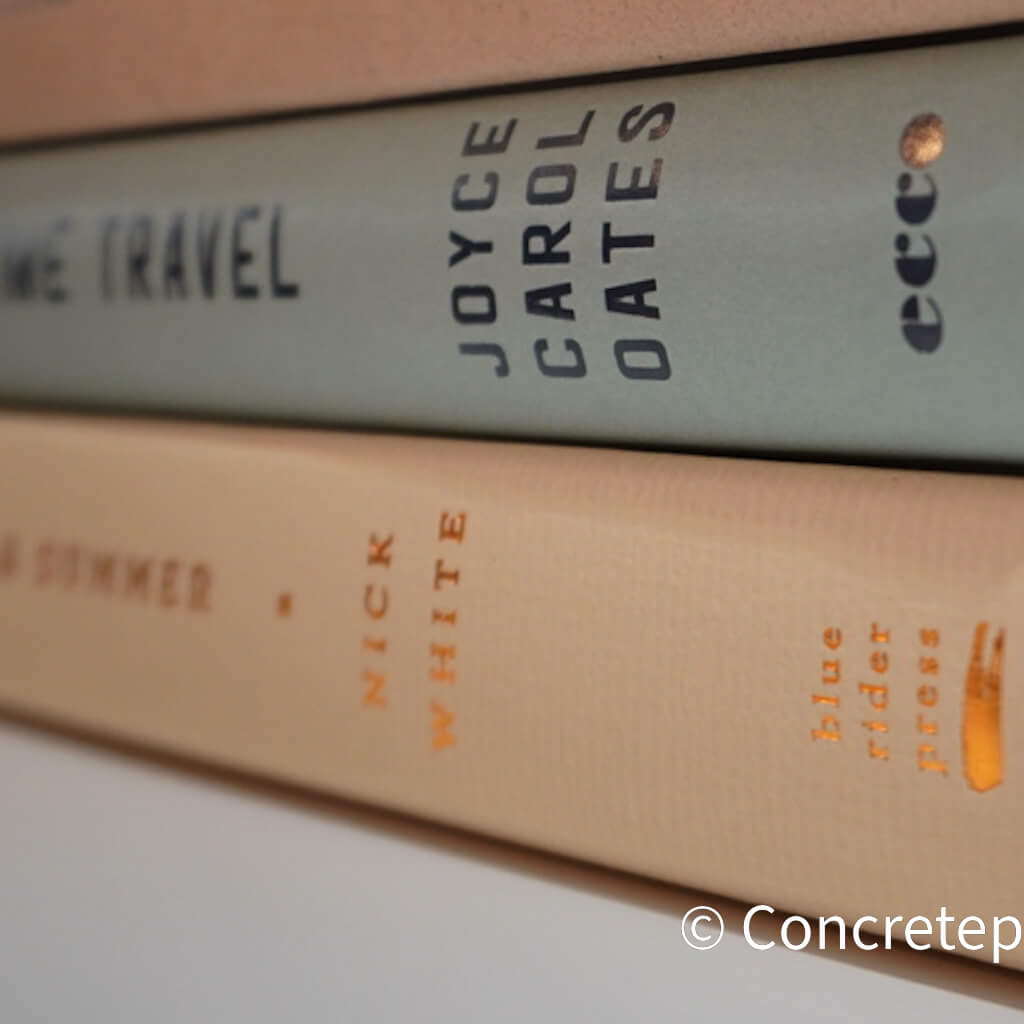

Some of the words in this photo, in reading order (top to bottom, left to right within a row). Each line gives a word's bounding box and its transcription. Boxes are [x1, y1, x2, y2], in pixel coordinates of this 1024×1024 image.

[99, 203, 299, 302] TRAVEL
[449, 117, 518, 378] JOYCE
[522, 109, 596, 378] CAROL
[602, 101, 676, 381] OATES
[361, 532, 395, 709] NICK
[429, 510, 467, 751] WHITE
[811, 625, 843, 743] blue
[858, 622, 891, 761] rider
[916, 627, 949, 776] press
